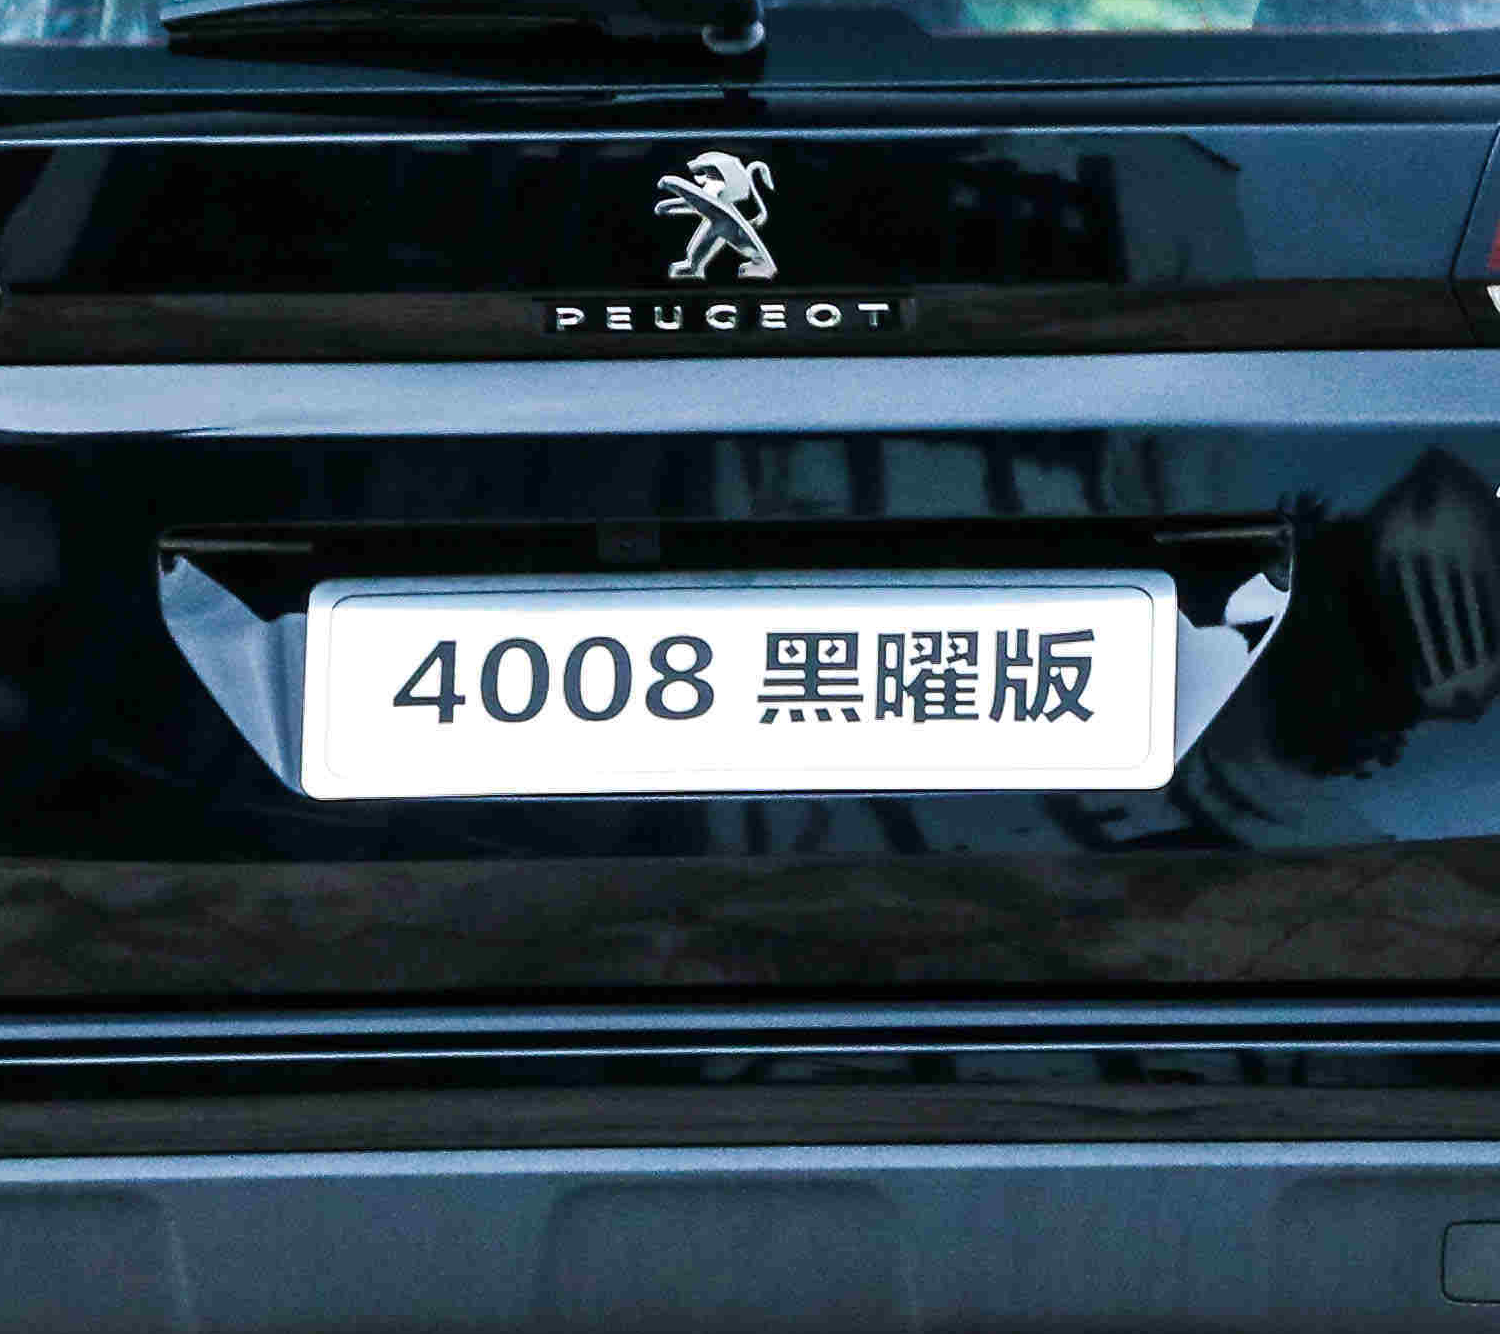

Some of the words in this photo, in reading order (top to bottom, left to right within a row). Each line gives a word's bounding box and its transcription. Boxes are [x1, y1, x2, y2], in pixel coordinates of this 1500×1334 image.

[555, 301, 892, 331] PEUGEOT
[393, 634, 716, 725] 4008
[755, 627, 1096, 725] 黑曜版
